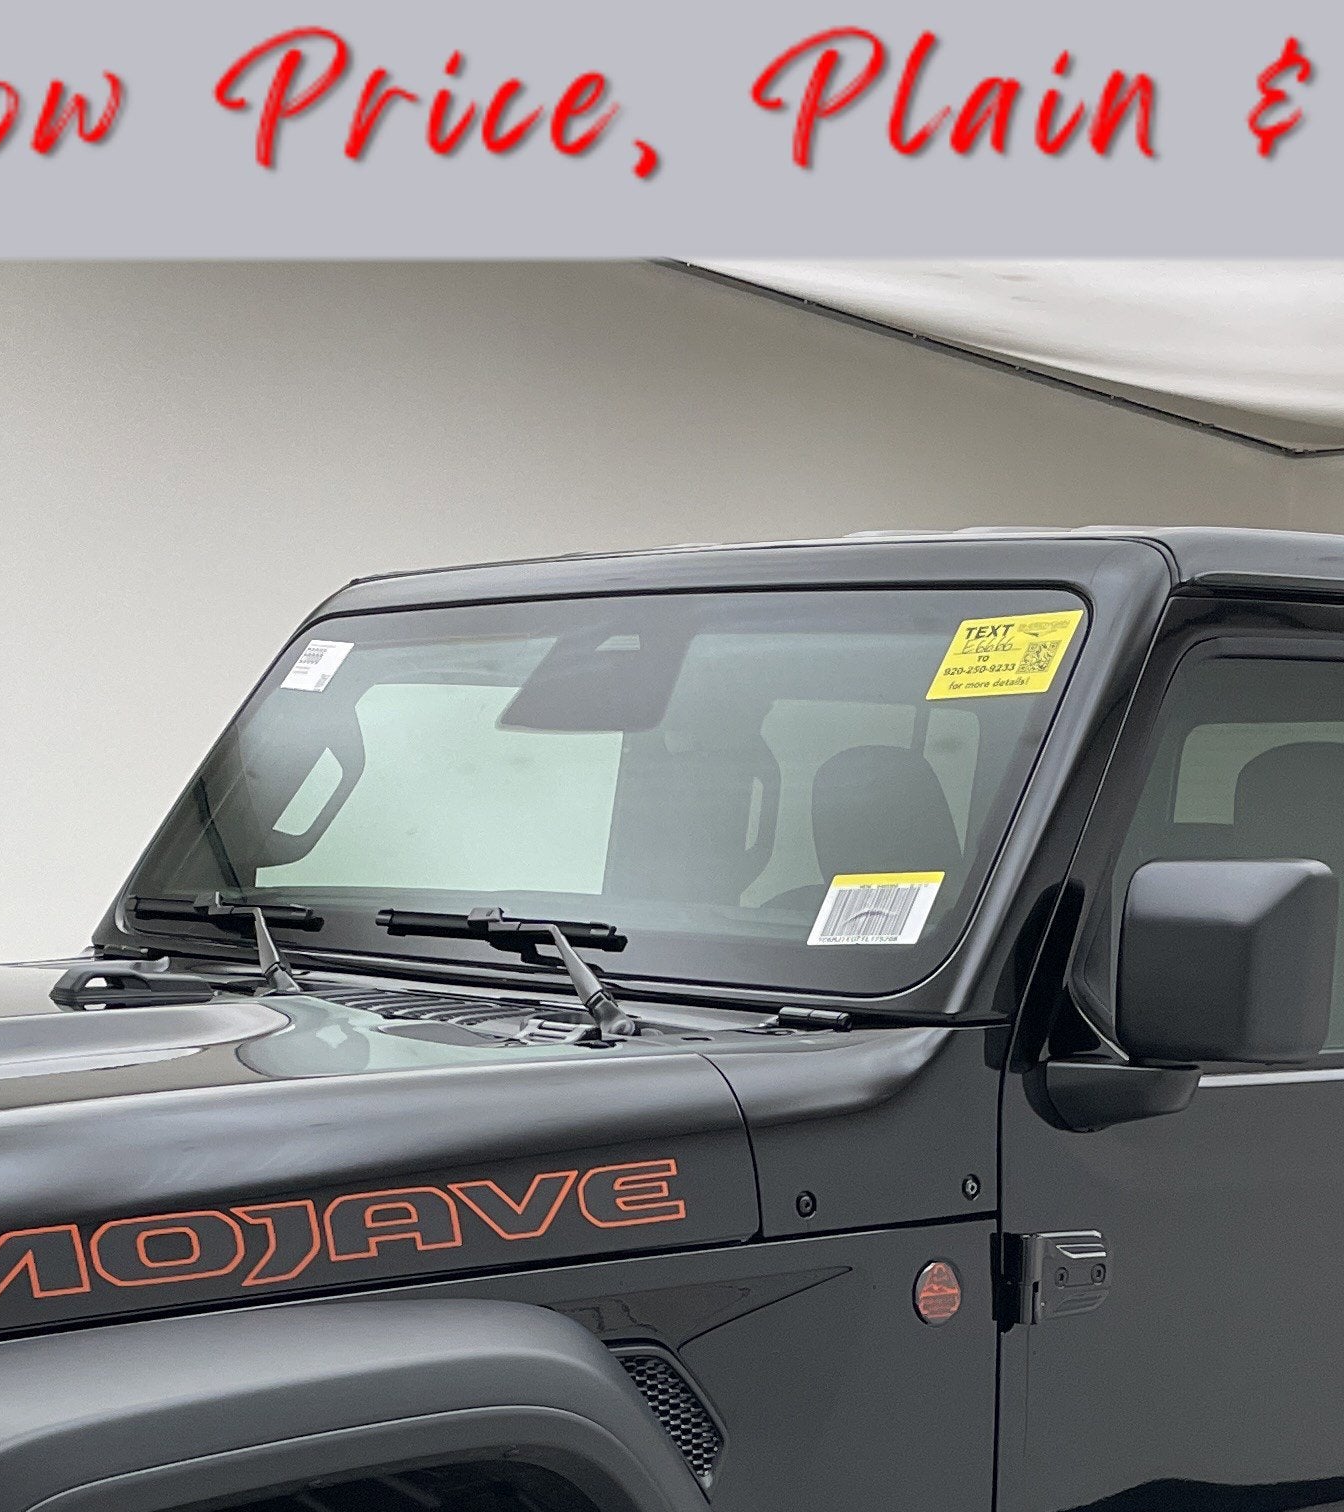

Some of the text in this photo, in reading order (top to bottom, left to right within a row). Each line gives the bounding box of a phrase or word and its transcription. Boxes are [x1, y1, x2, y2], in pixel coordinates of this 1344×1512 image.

[965, 623, 1015, 640] TEXT
[976, 655, 990, 663] TO
[948, 681, 964, 691] for
[964, 680, 991, 690] more
